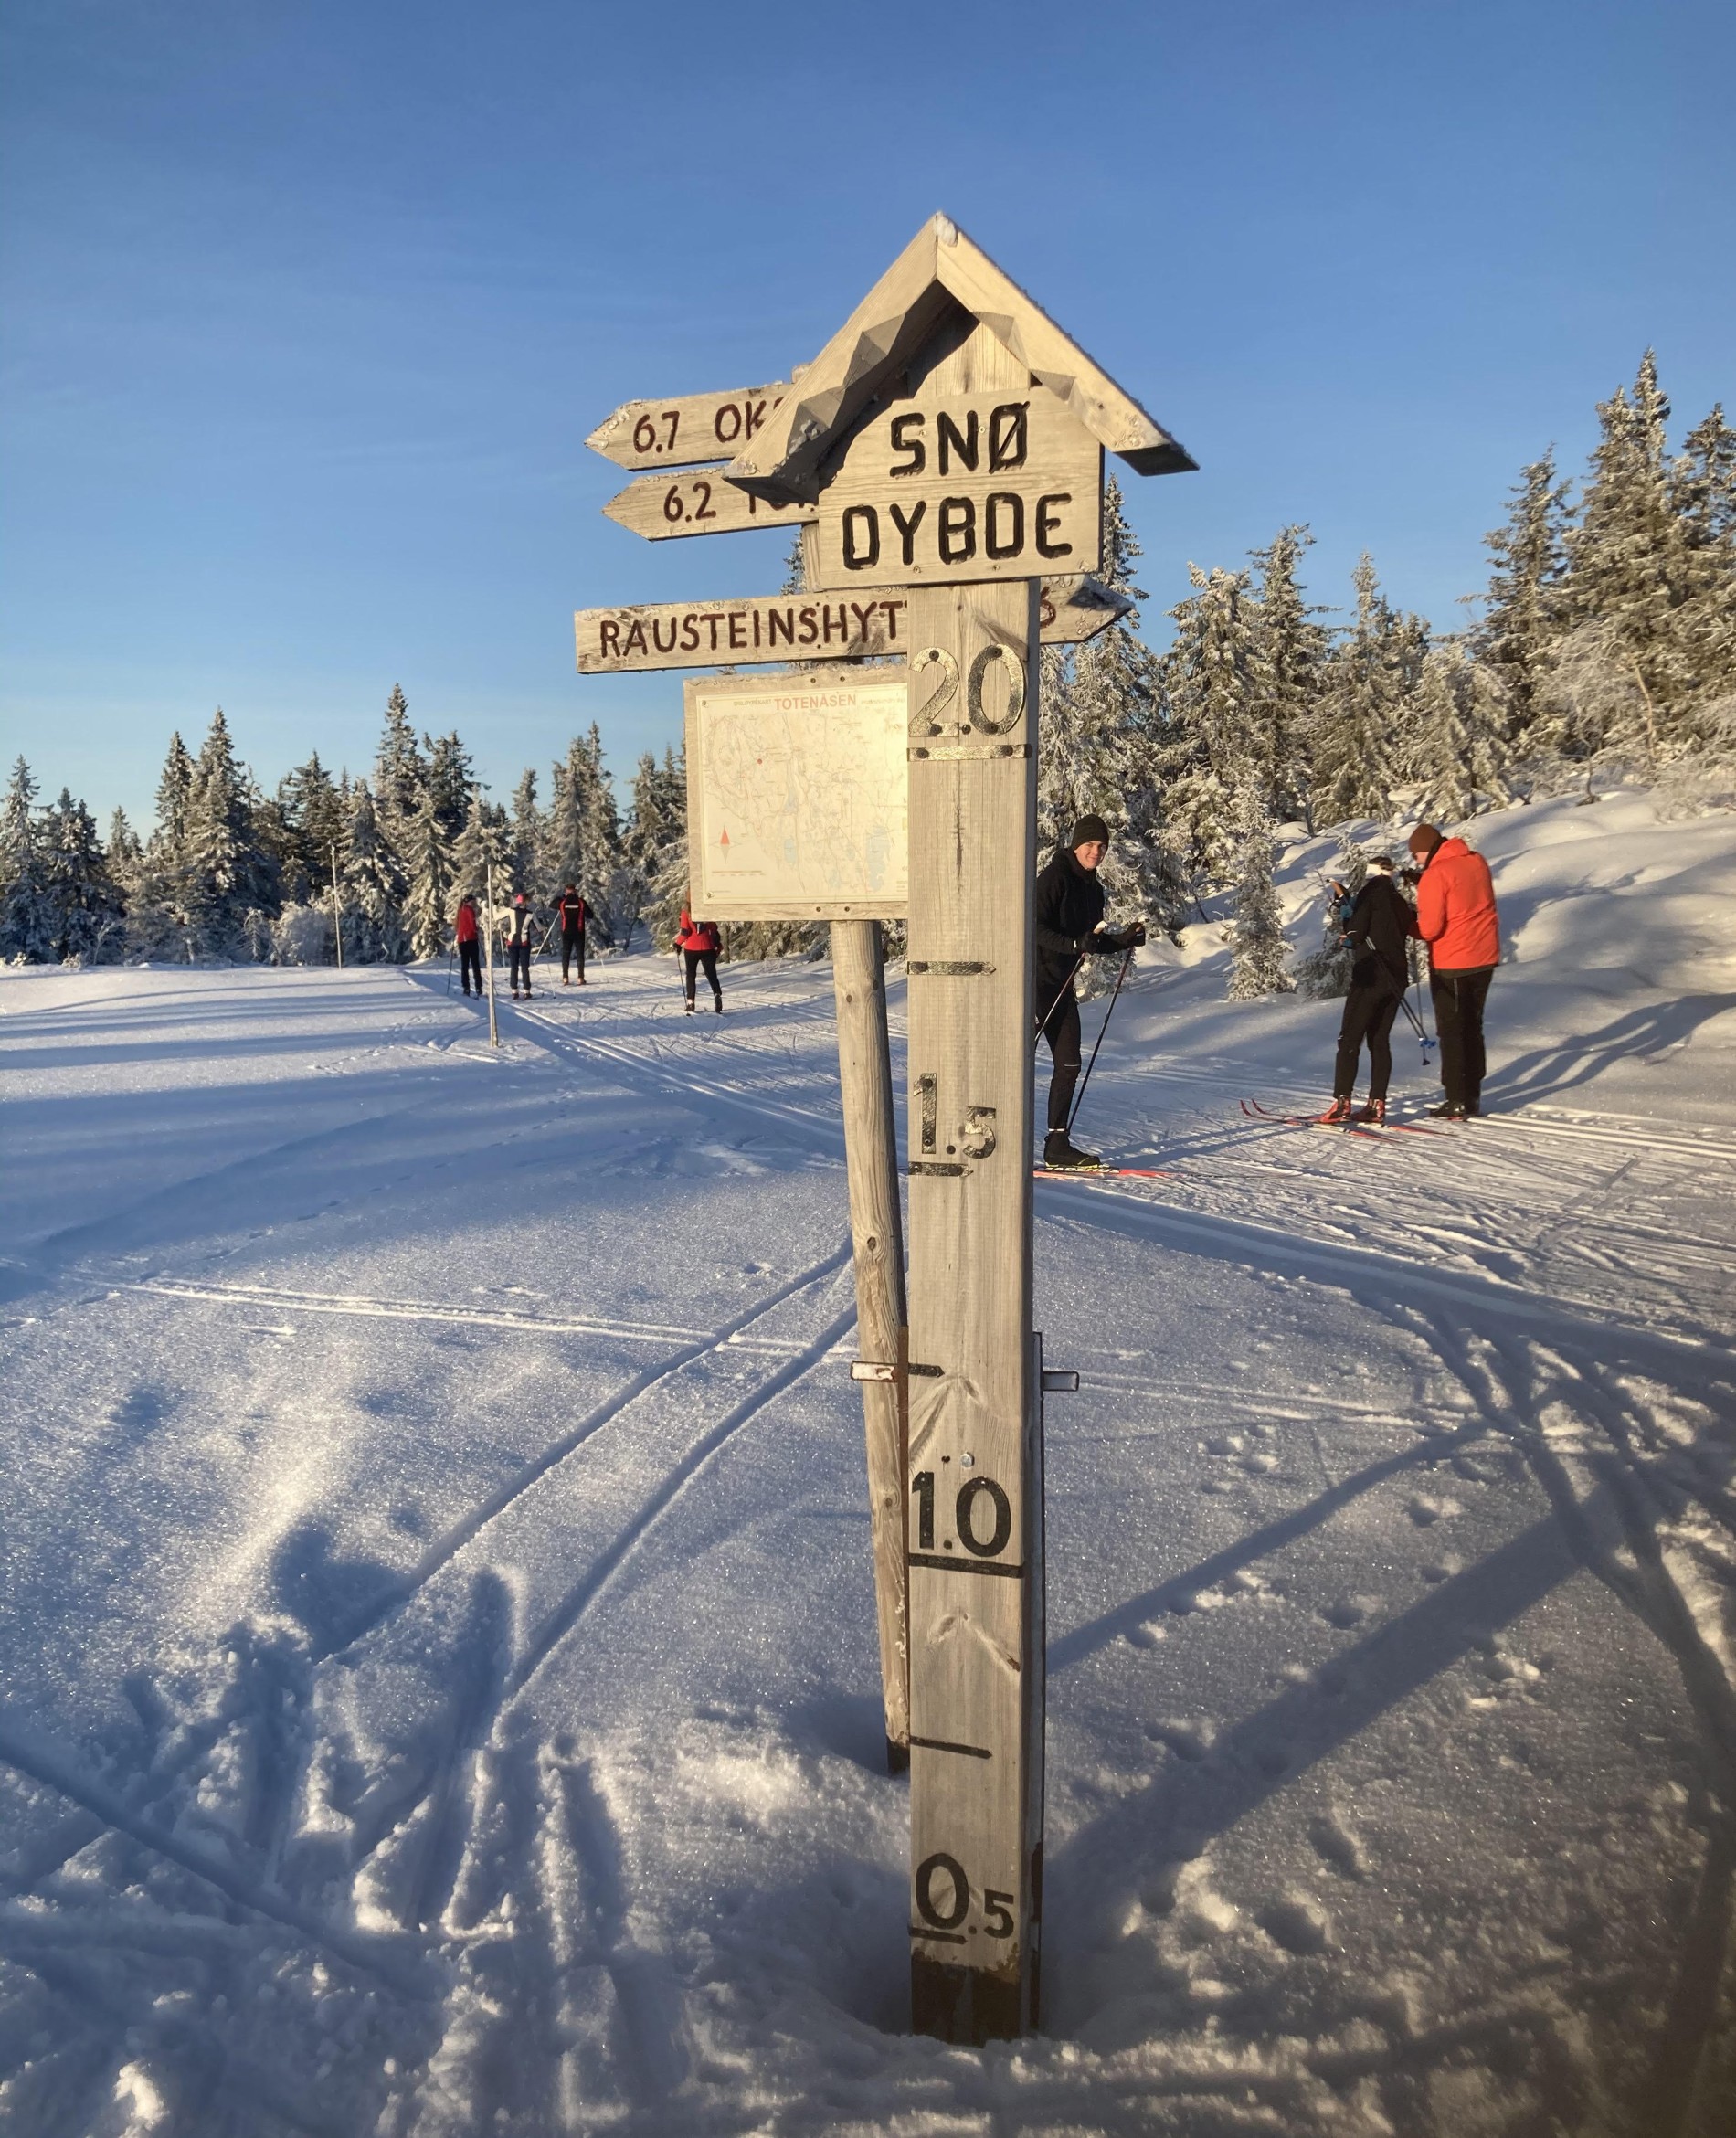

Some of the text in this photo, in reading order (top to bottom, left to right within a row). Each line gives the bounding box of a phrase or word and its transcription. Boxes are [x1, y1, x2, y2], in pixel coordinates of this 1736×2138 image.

[632, 397, 784, 453] 6.7 OK
[890, 400, 1030, 477] SNØ
[663, 481, 716, 522] 6.2
[842, 492, 1073, 570] DYBDE
[599, 599, 907, 658] RAUSTEINSHYT
[774, 693, 857, 711] TOTENÅSEN
[908, 643, 1026, 737] 2.0
[913, 1072, 996, 1159] 1.5
[912, 1471, 1011, 1557] 1.0
[916, 1852, 1014, 1939] 0.5
